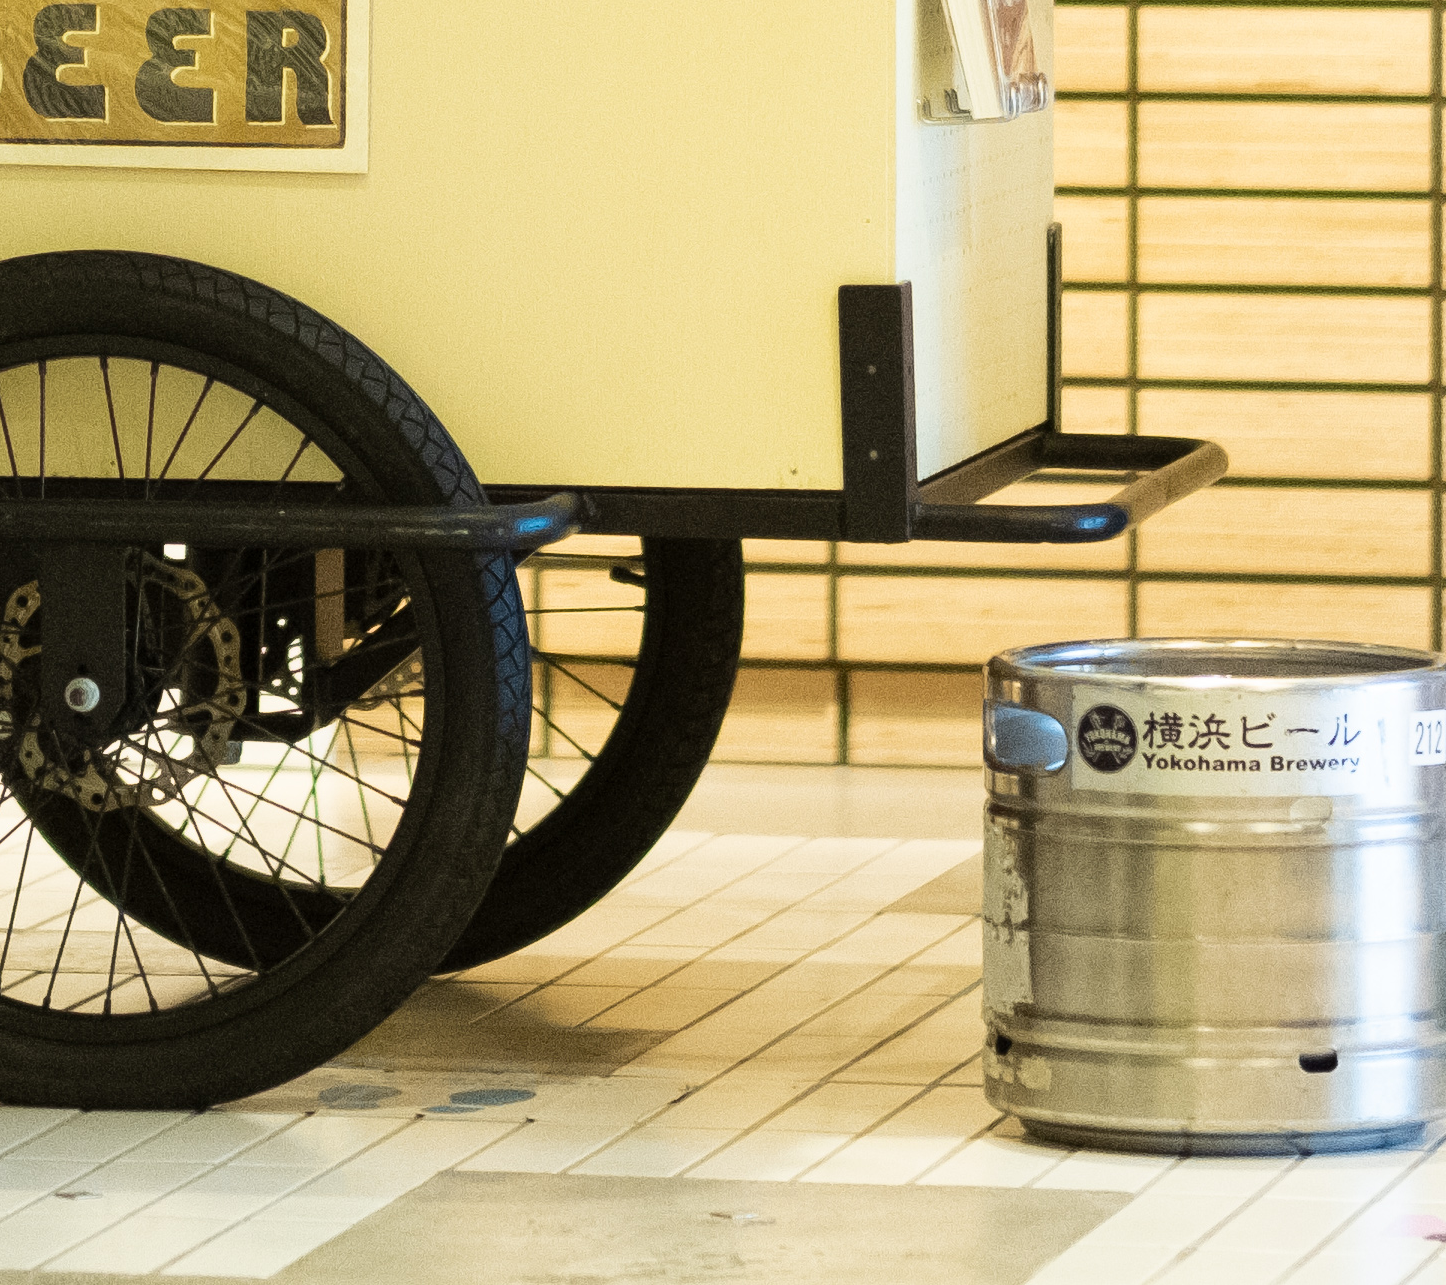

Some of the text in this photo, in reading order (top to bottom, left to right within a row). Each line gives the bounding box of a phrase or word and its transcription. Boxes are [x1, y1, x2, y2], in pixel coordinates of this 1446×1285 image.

[1142, 712, 1362, 752] 横浜ビール
[1414, 720, 1445, 756] 212
[1142, 752, 1361, 774] Yokohama Brewery
